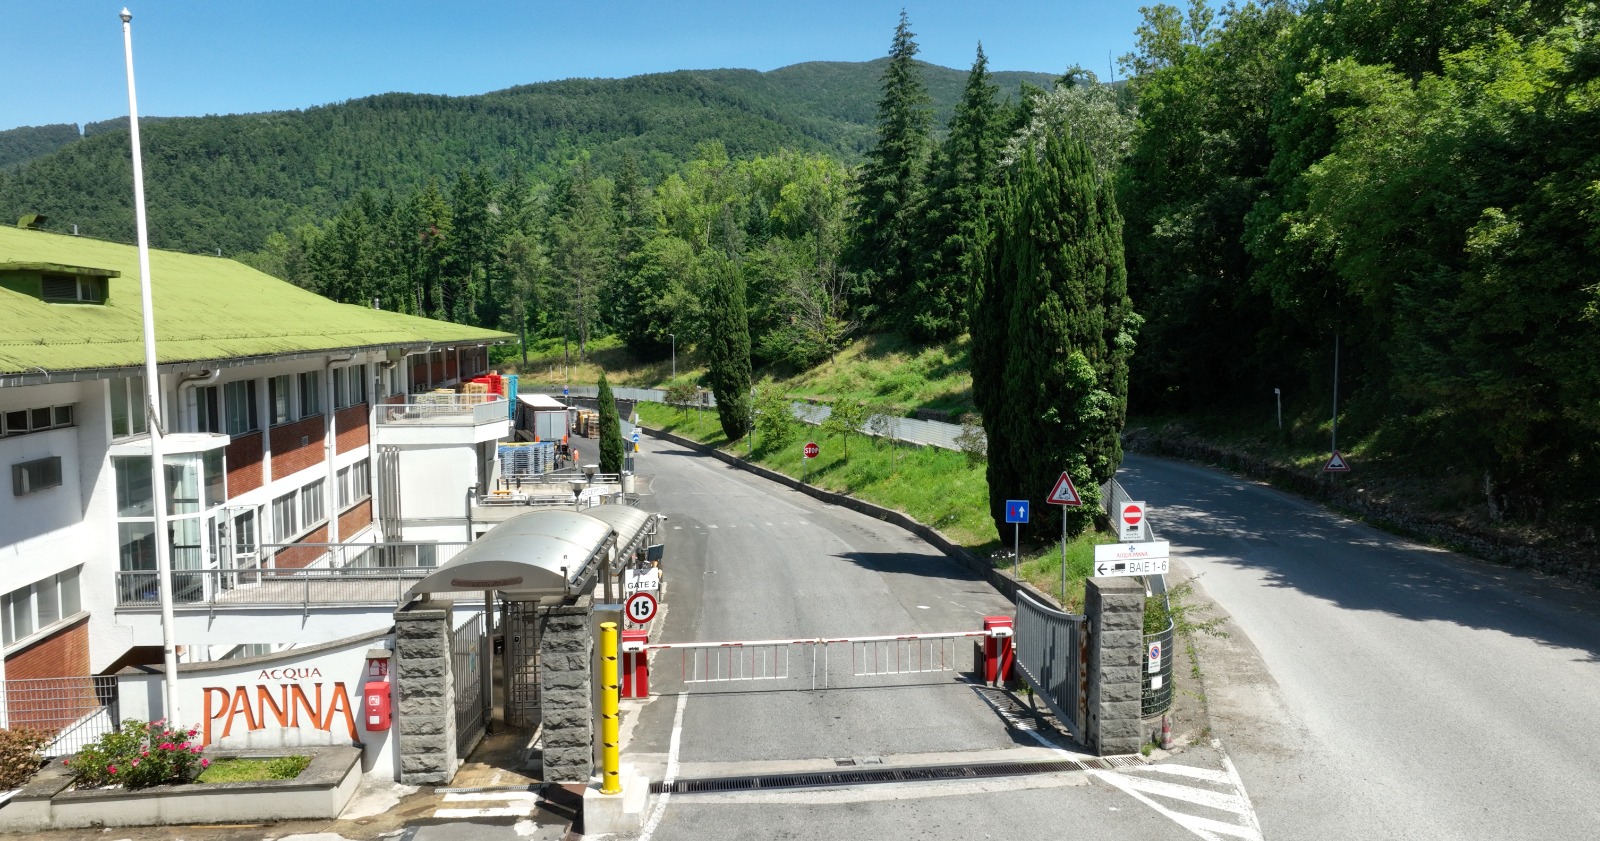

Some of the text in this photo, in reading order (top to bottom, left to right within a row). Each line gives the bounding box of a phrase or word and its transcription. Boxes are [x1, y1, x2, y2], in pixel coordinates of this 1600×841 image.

[1129, 561, 1150, 573] BAIE
[627, 580, 657, 590] GATE 2
[633, 601, 650, 616] 15
[258, 667, 323, 680] ACQUA
[202, 681, 361, 747] PANNA
